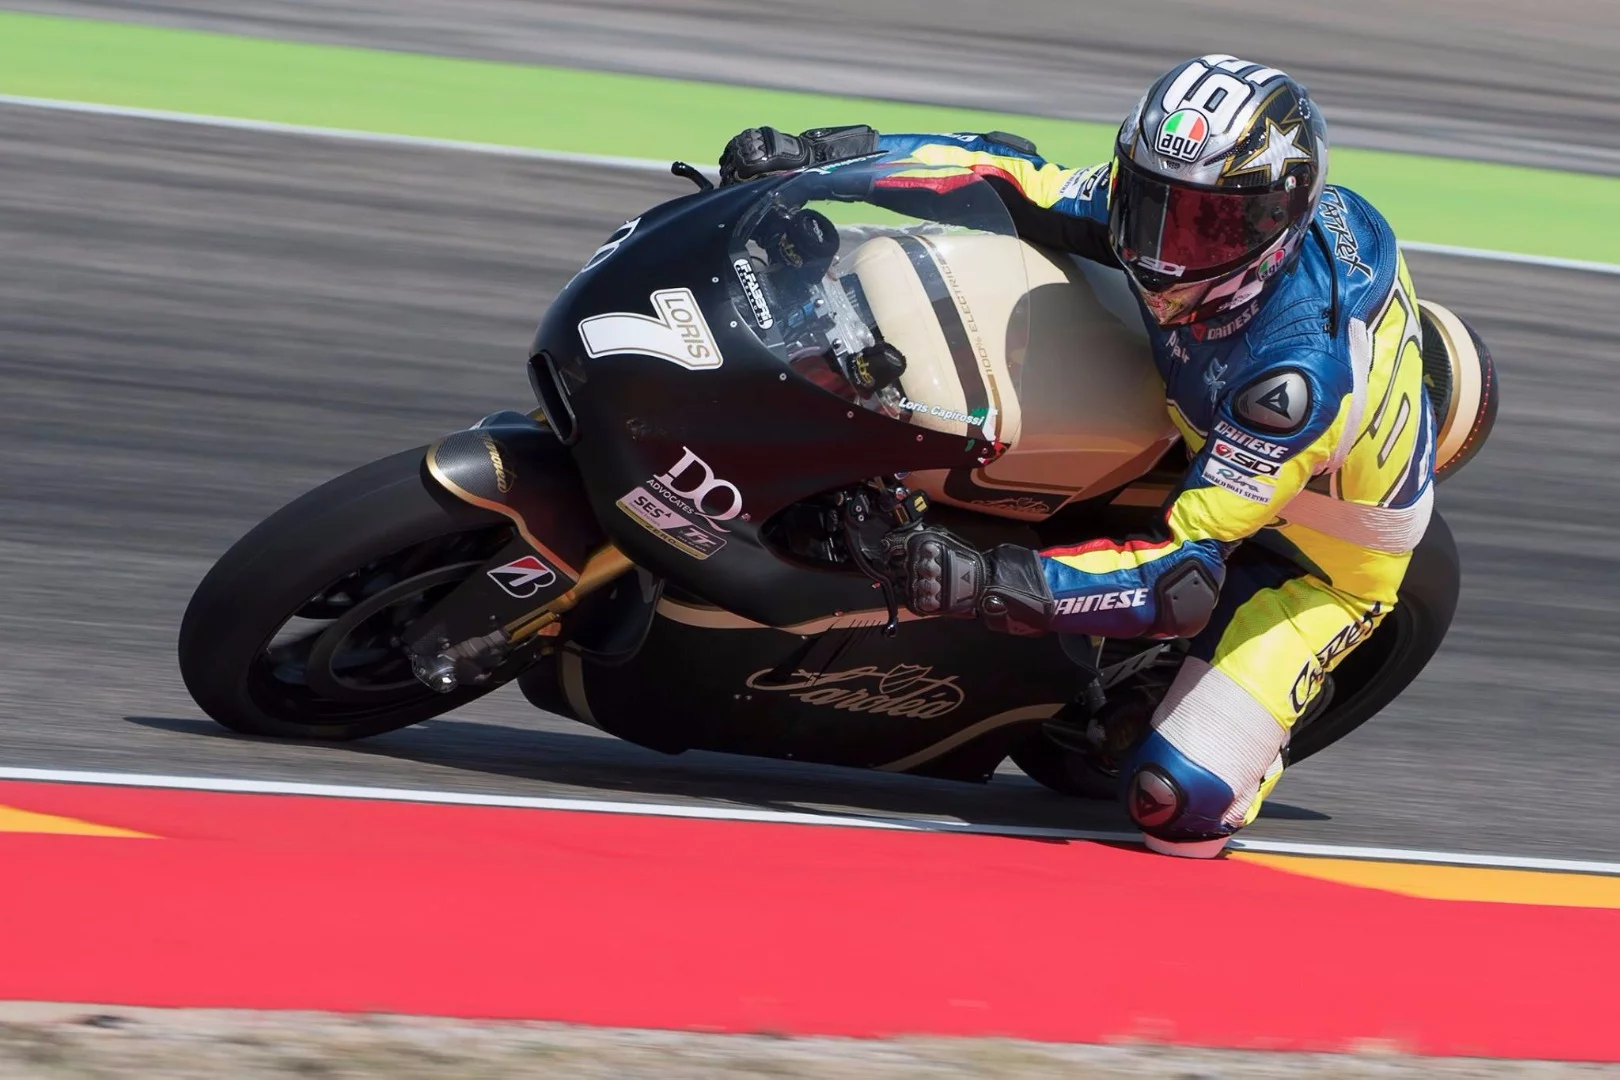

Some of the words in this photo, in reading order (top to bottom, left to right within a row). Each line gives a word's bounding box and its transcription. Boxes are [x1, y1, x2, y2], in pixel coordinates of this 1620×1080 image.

[1161, 133, 1199, 158] agv
[663, 297, 711, 360] LORIS
[1207, 298, 1260, 341] DAINESE
[898, 396, 928, 413] Loris
[930, 405, 986, 427] Capirossi
[1213, 420, 1290, 460] DAINESE
[1230, 451, 1281, 476] SIDI
[633, 495, 664, 520] SES
[646, 479, 695, 515] ADVOCATES
